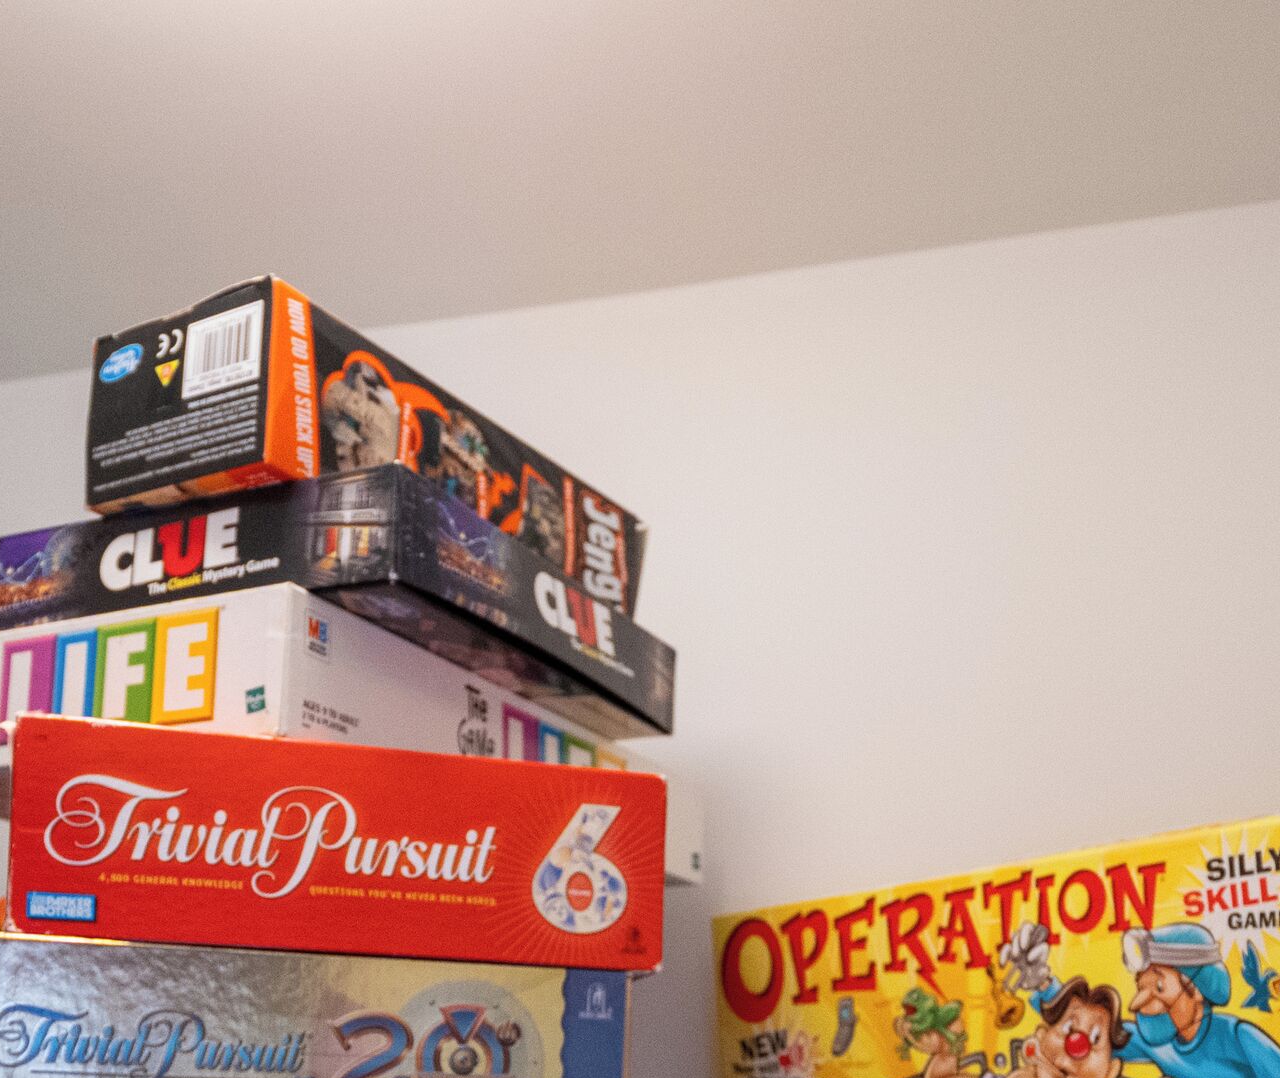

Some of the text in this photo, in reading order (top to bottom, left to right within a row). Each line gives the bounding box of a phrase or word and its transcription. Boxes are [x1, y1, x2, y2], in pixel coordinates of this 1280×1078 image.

[287, 297, 307, 338] HOW
[290, 335, 309, 361] DO
[293, 363, 311, 395] YOU
[294, 394, 314, 446] STACK
[99, 506, 241, 592] CLUE
[148, 557, 280, 596] The Classic Mystery Game
[534, 570, 616, 657] CLUE
[4, 618, 210, 721] LIFE
[43, 774, 497, 898] Trivial Pursuit
[181, 877, 244, 890] KNOWLEDGE
[532, 803, 628, 934] 6
[309, 885, 365, 897] QUESTIONS
[1183, 877, 1278, 917] SKILL
[721, 861, 1166, 1024] OPERATION
[740, 1029, 788, 1058] NEW
